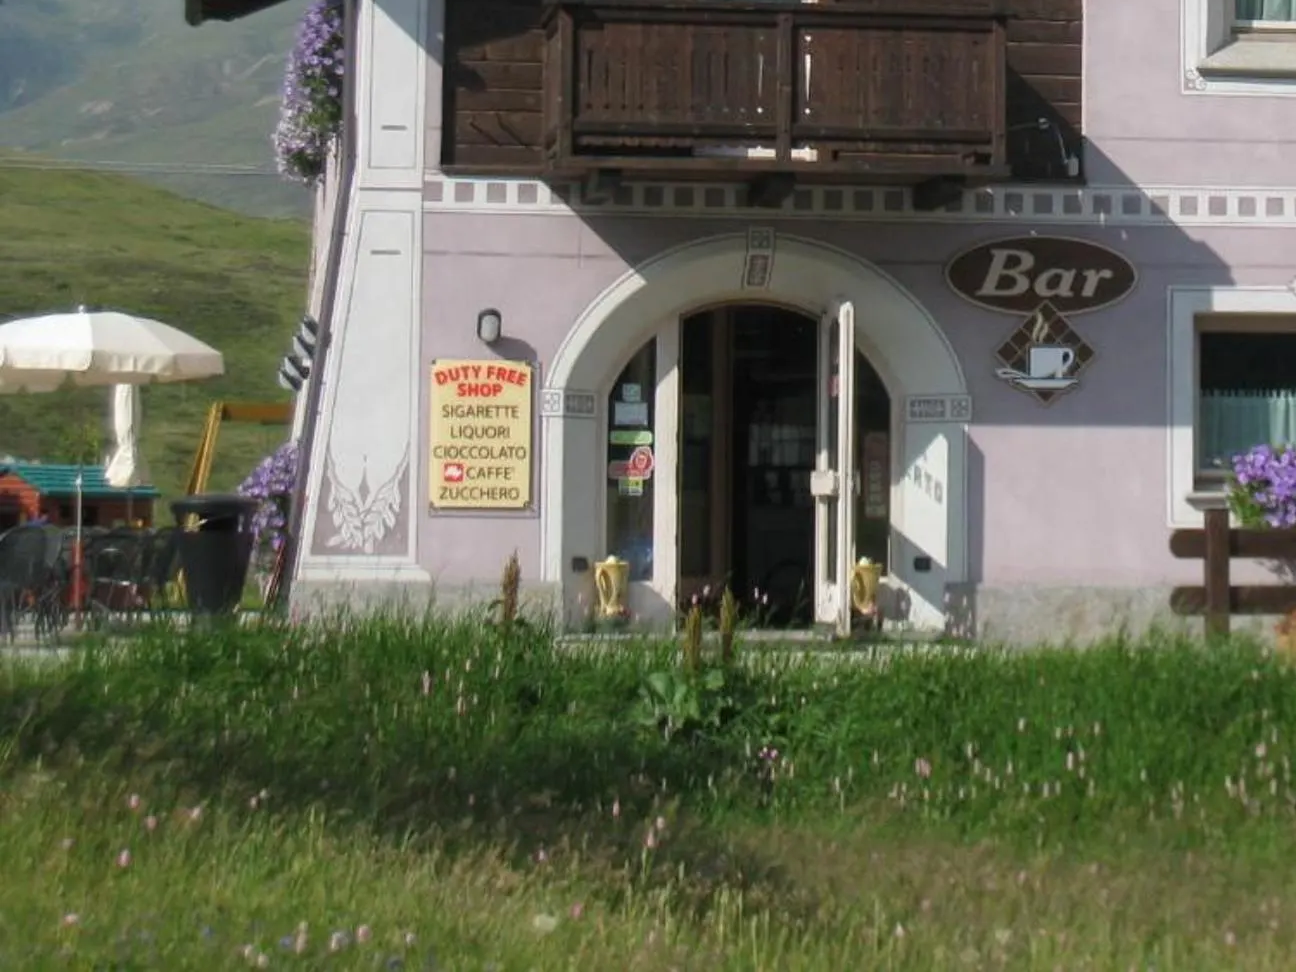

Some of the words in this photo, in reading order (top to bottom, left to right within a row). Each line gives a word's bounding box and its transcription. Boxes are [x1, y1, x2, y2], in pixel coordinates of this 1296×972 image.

[974, 247, 1114, 298] Bar
[434, 364, 482, 385] DUTY
[487, 365, 528, 387] FREE
[457, 383, 504, 397] SHOP
[441, 404, 520, 419] SIGARETTE
[450, 425, 511, 440] LIQUORI
[433, 445, 527, 460] CIOCCOLATO
[439, 486, 520, 501] ZUCCHERO
